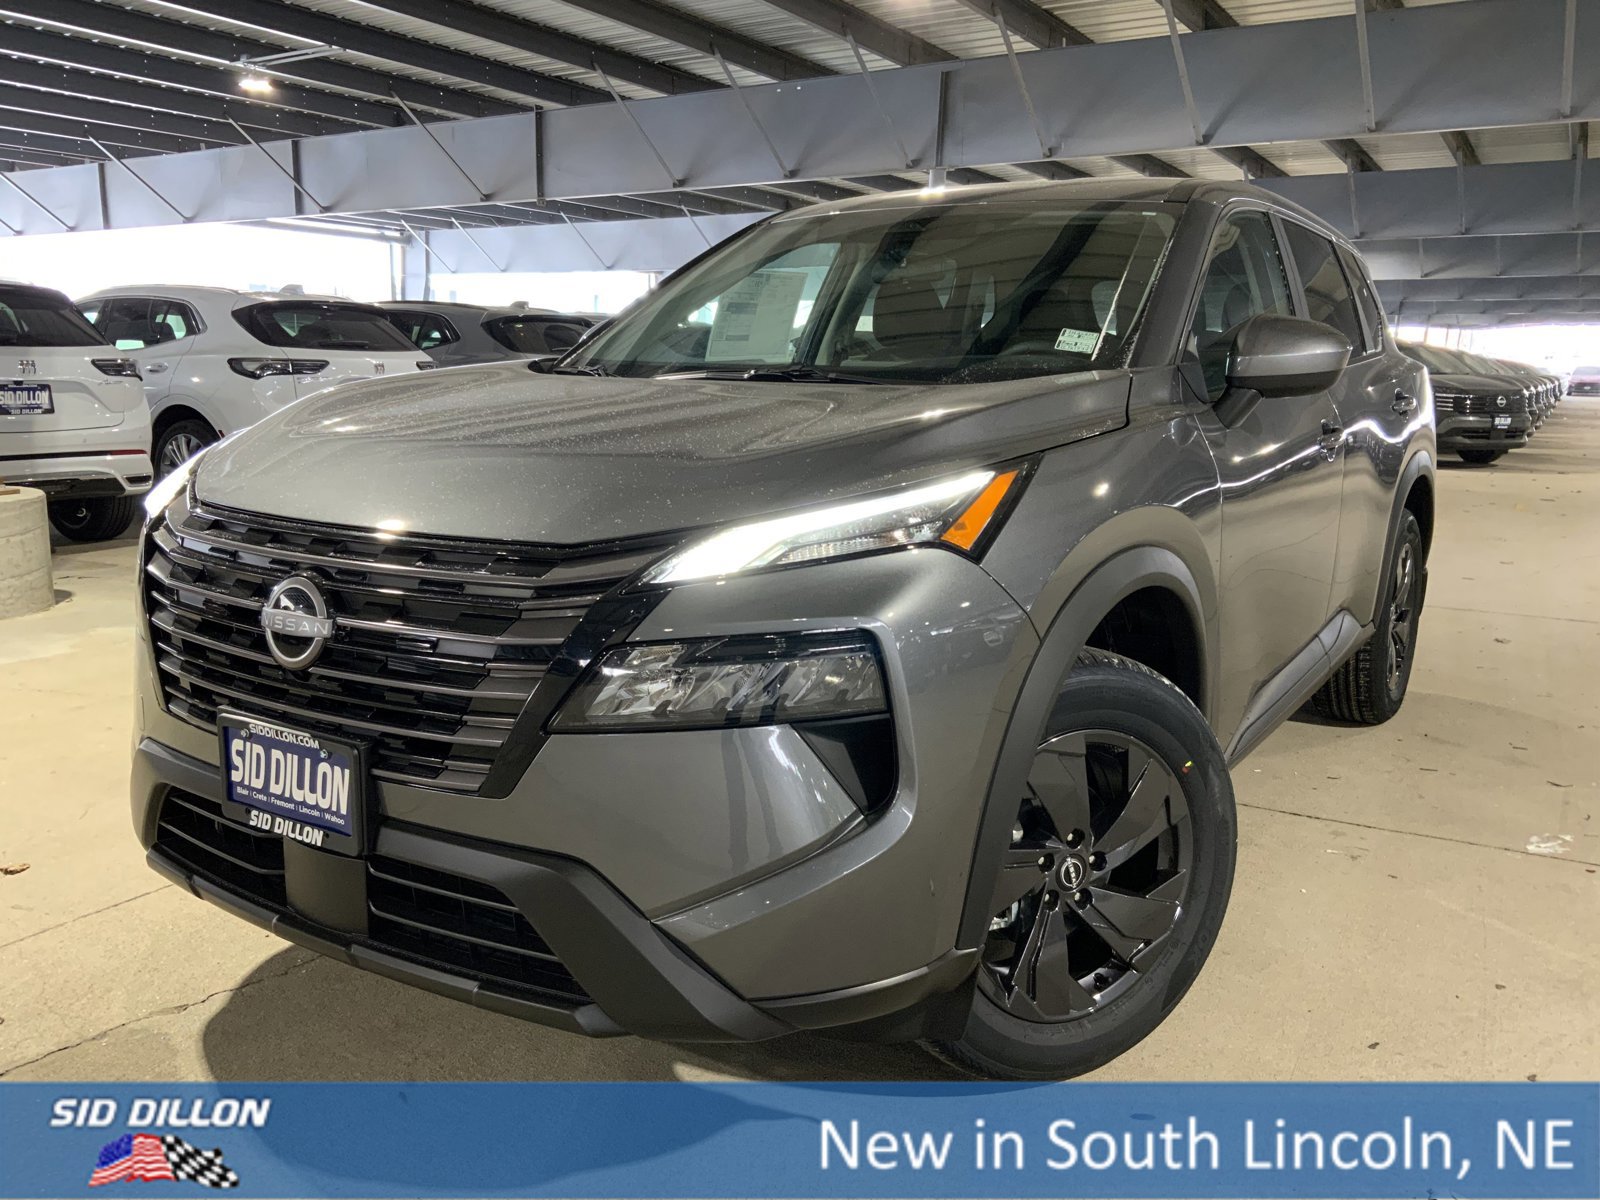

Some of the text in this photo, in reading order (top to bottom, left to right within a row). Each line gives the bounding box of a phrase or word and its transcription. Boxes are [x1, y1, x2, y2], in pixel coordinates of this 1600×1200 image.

[16, 391, 49, 404] DILLON
[263, 613, 328, 634] NISSAN
[249, 724, 320, 750] SIDDILLON.COM
[231, 738, 350, 816] SID DILLON
[236, 785, 345, 826] Blair Crete Fremont Lincoln Wahoo
[249, 810, 324, 847] SID DILLON
